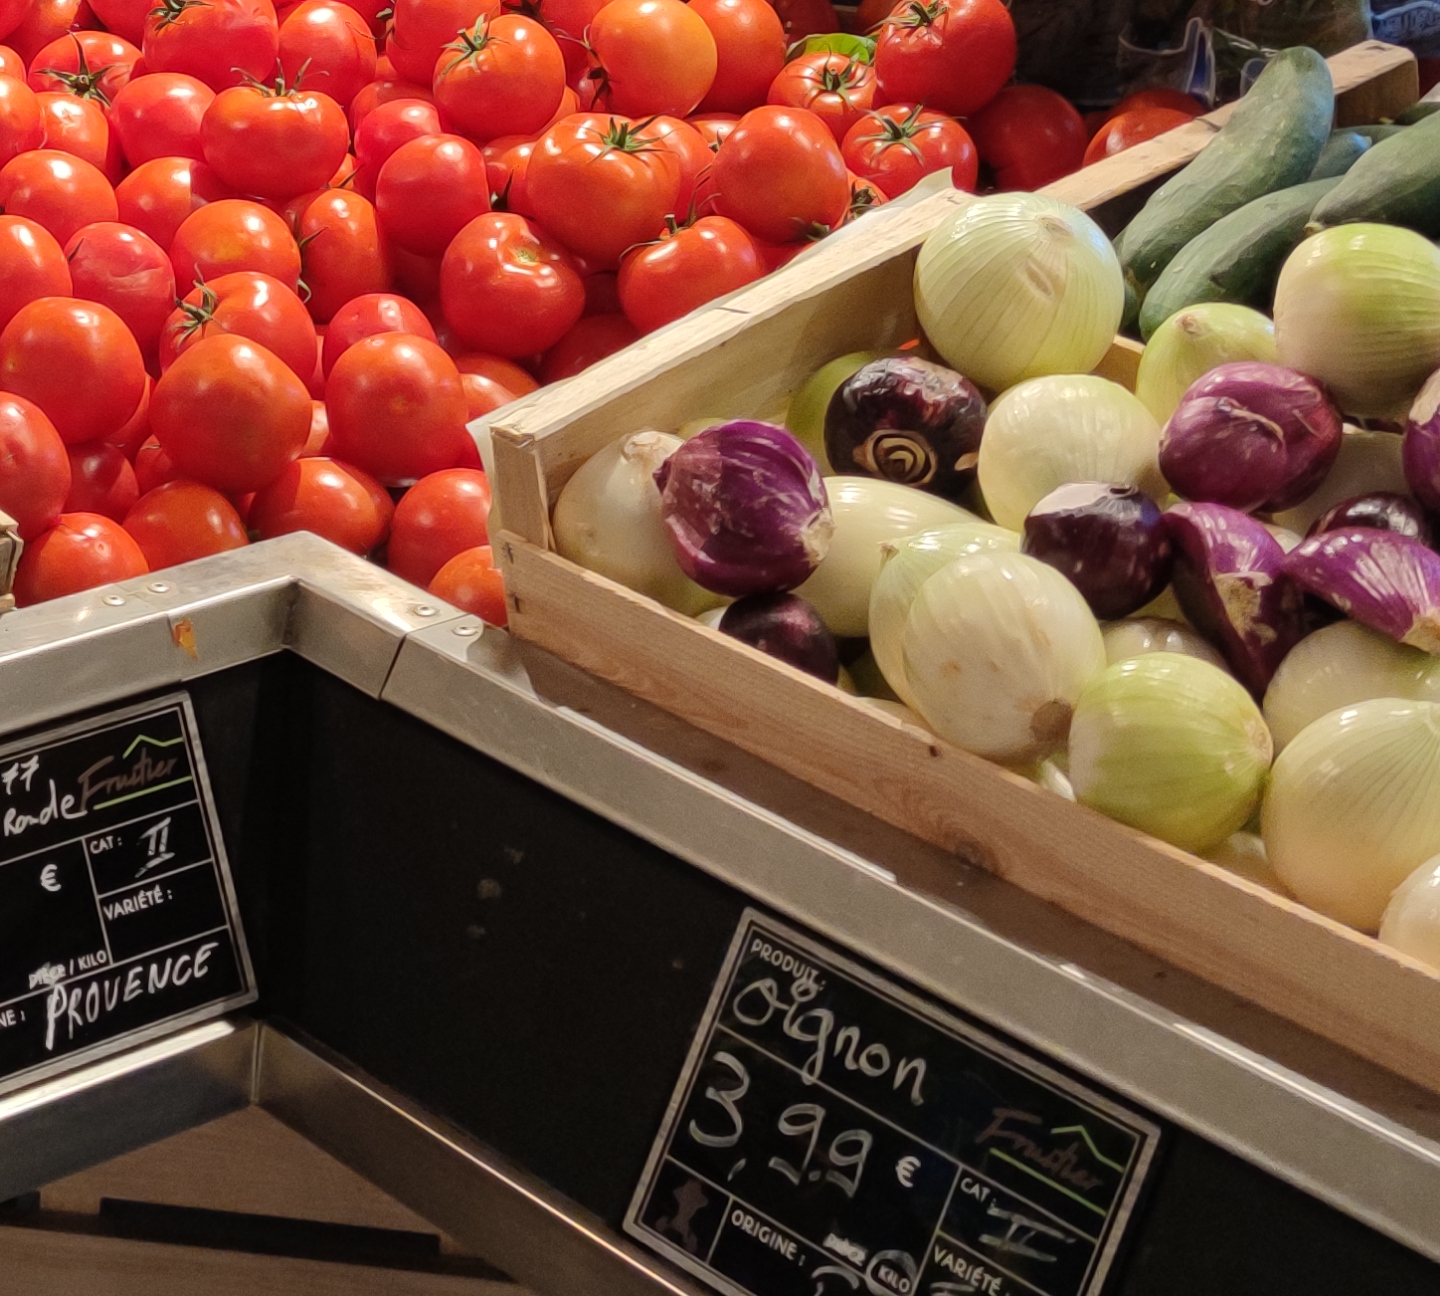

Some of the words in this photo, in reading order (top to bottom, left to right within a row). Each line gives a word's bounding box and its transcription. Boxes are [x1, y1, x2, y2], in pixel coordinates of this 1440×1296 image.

[90, 835, 116, 854] CAT
[40, 864, 63, 891] €
[103, 884, 165, 921] VARIÉTÉ
[78, 949, 108, 971] KILO
[750, 939, 820, 983] PRODUIT
[44, 942, 220, 1051] PROVENCE
[688, 1051, 873, 1199] 3,99
[896, 1155, 921, 1189] €
[960, 1176, 990, 1202] CAT
[731, 1208, 799, 1263] ORIGINE
[878, 1264, 911, 1294] KILO
[933, 1245, 1004, 1296] VARIÉTÉ
